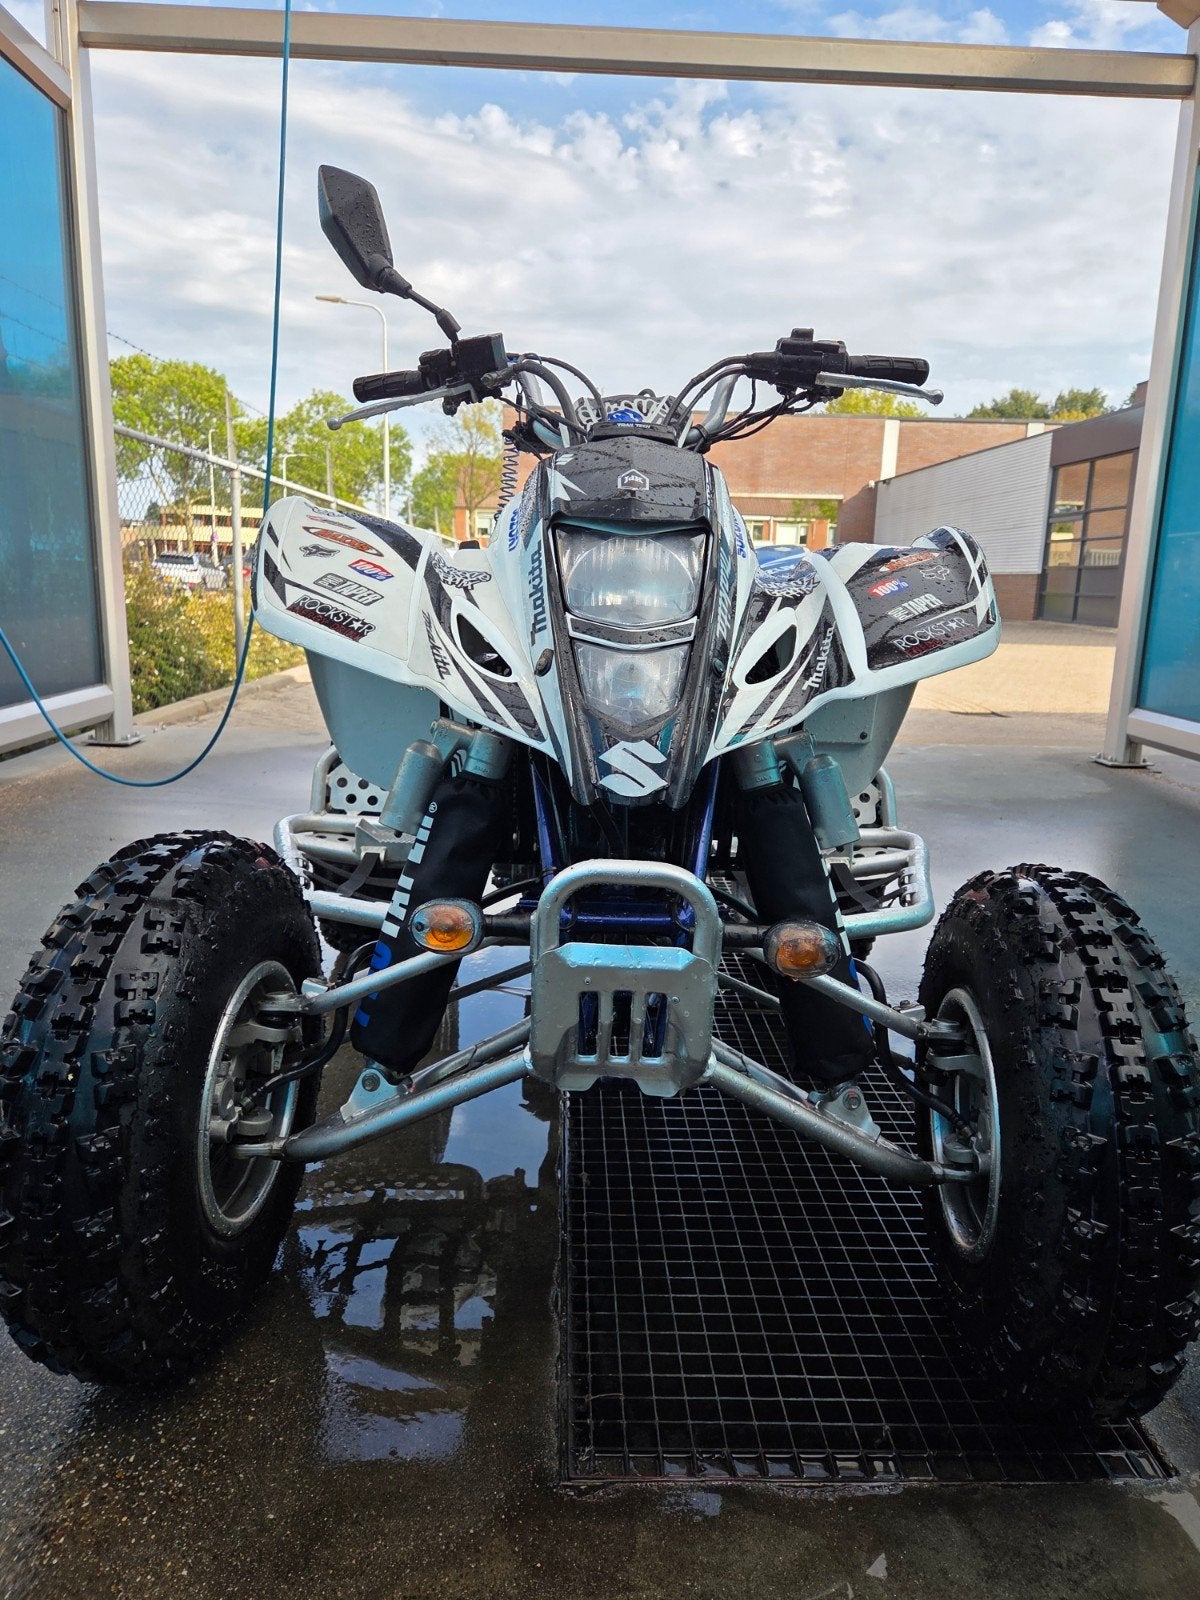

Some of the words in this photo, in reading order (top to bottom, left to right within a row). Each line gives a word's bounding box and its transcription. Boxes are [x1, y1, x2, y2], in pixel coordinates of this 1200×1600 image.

[351, 560, 392, 581] 100%
[335, 580, 384, 605] TAPER
[872, 580, 909, 597] 100%
[901, 593, 943, 616] TAPER
